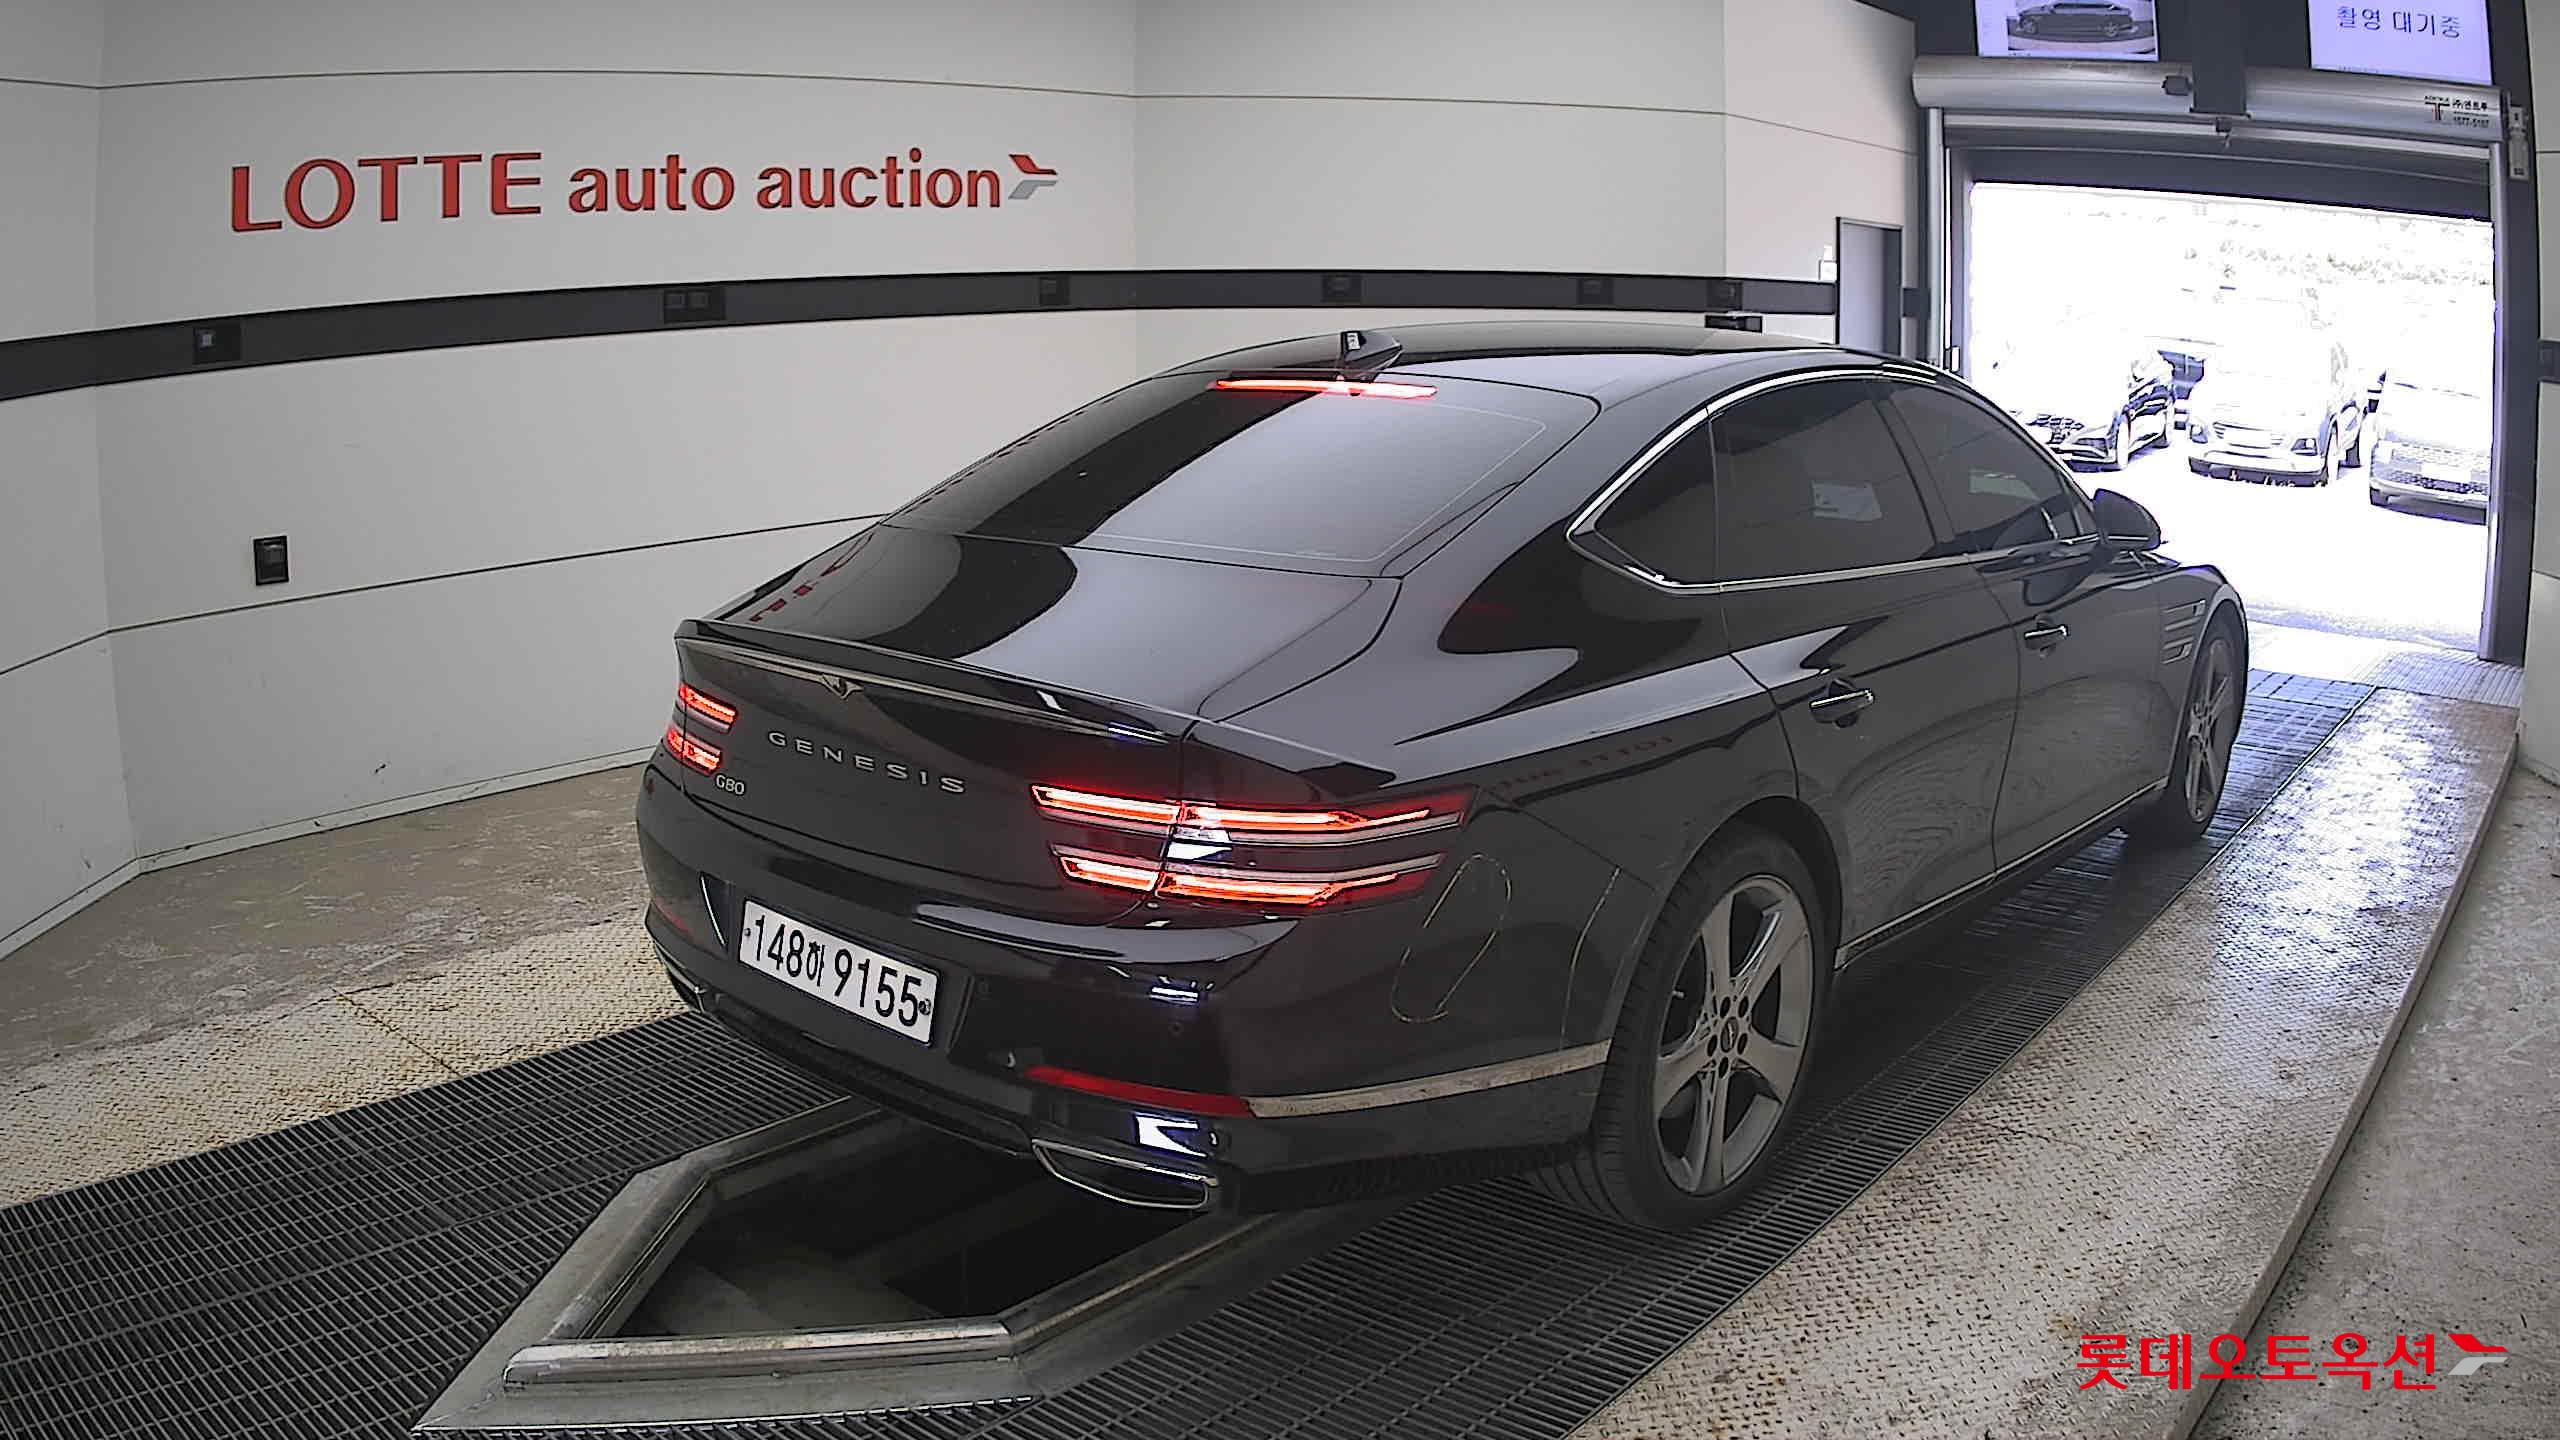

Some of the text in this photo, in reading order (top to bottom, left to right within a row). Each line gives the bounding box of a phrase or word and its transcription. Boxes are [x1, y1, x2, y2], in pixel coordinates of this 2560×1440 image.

[2337, 6, 2461, 38] 촬영 대기중
[231, 148, 1002, 232] LOTTE auto auction
[715, 774, 746, 796] G80
[768, 731, 967, 794] GENESIS
[834, 949, 923, 1027] 9155
